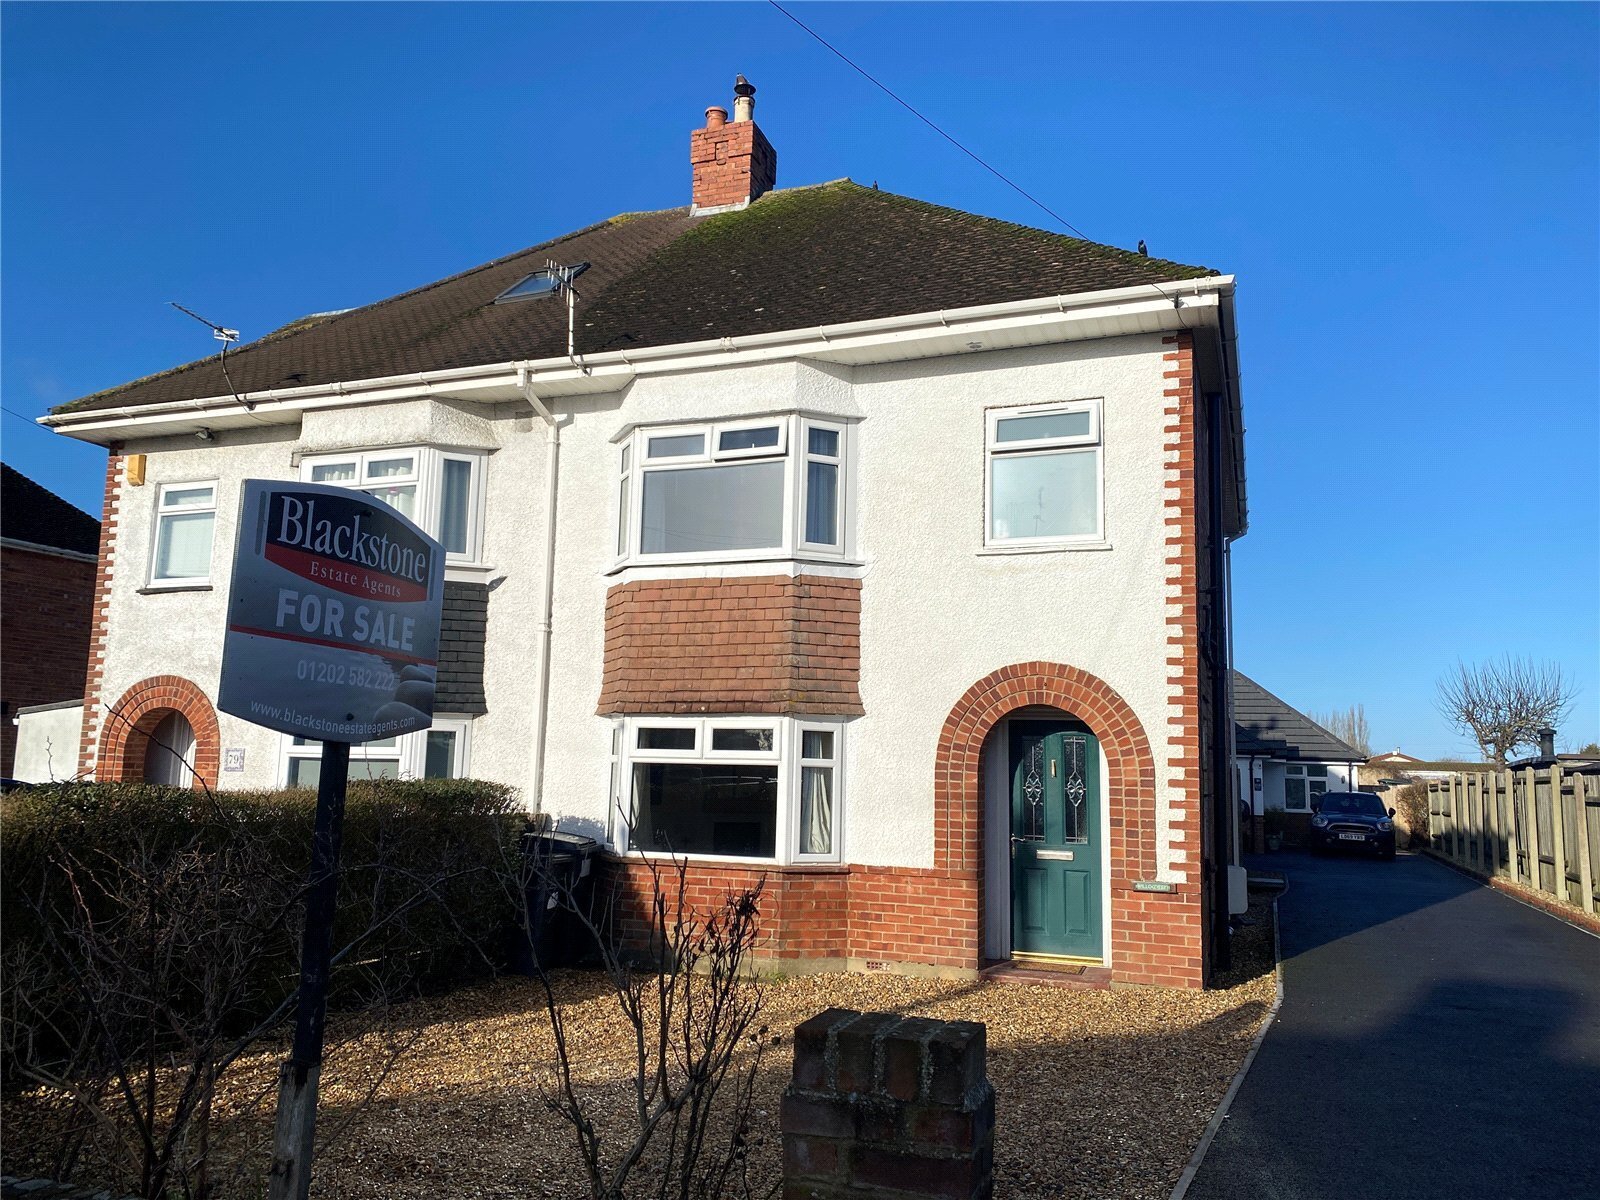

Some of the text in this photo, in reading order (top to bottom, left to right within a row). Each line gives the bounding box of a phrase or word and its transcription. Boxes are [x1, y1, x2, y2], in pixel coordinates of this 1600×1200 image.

[277, 495, 427, 583] Blackstone
[310, 561, 402, 599] Estate Agents
[275, 588, 416, 651] FOR SALE
[297, 660, 395, 692] 01202 582 222
[250, 700, 415, 736] www.blackstoneestateagents.com
[229, 754, 239, 765] 79
